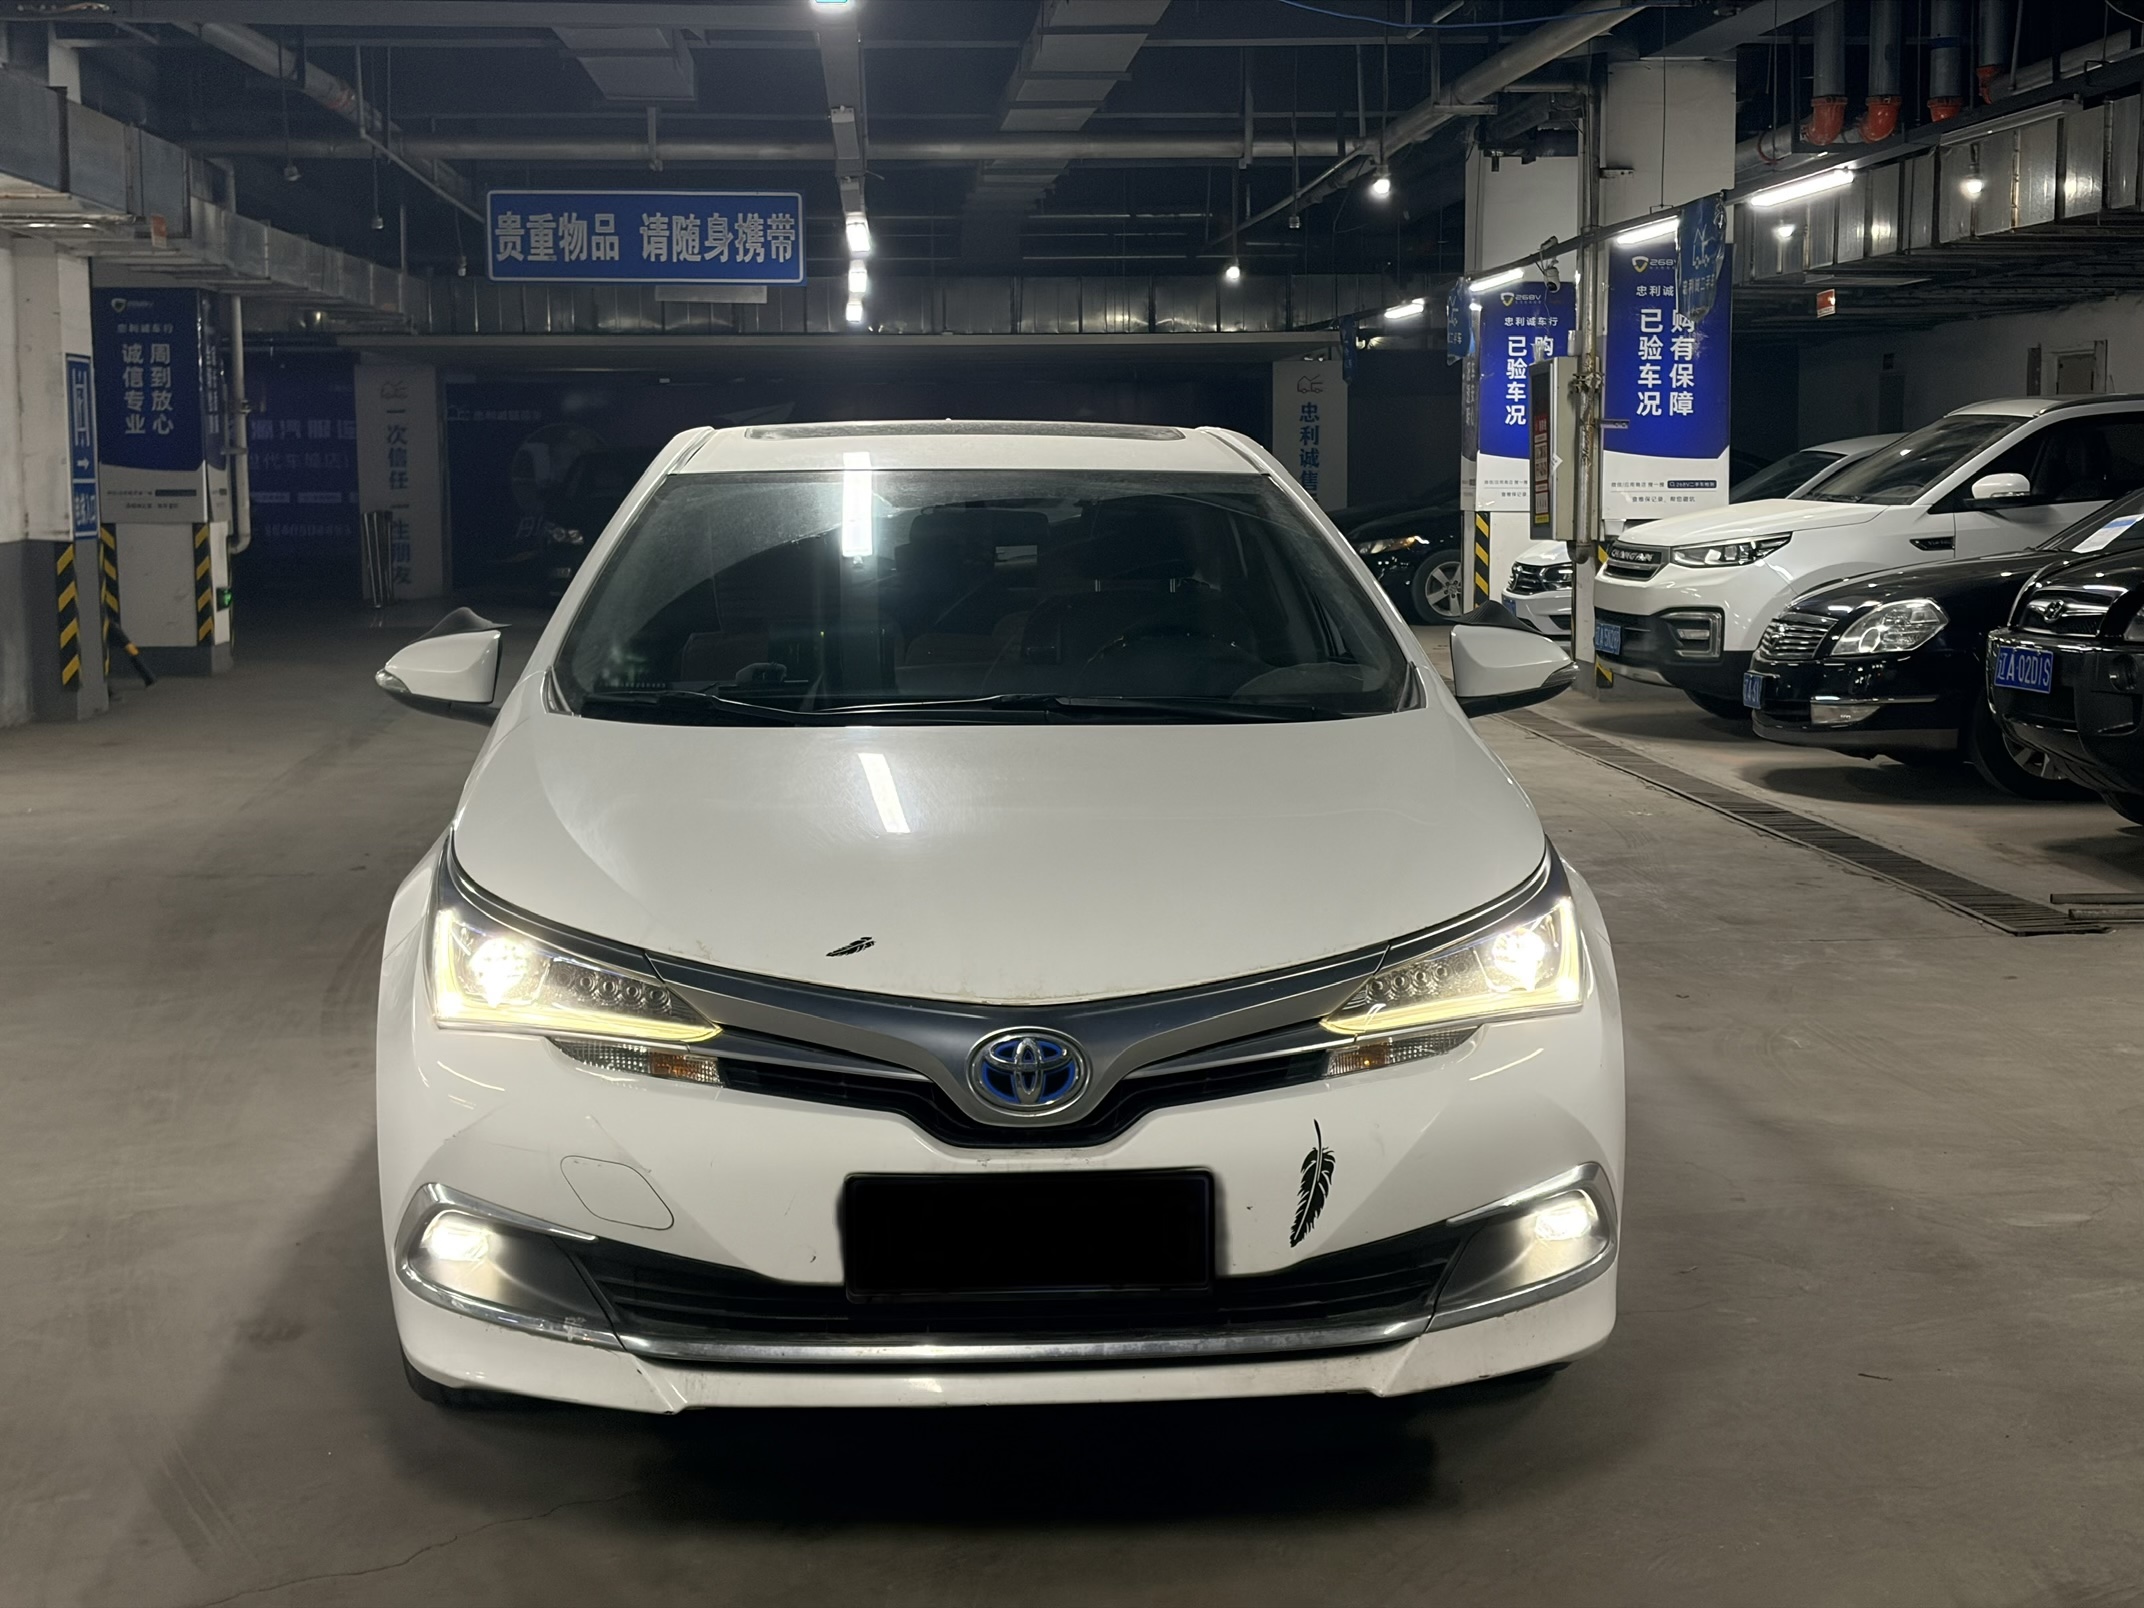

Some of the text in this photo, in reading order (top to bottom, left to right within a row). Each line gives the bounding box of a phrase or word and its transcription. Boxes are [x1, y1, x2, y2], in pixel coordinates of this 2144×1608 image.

[494, 210, 796, 263] 贵重物品 请随身携带
[1649, 258, 1676, 266] 268
[1504, 316, 1559, 327] 忠利诚车行
[1636, 308, 1663, 416] 已验车况
[1669, 310, 1696, 416] 购有保障
[121, 343, 146, 434] 诚信专业
[150, 343, 174, 435] 周到放心
[1505, 336, 1528, 426] 已验车况
[1299, 402, 1320, 501] 忠利诚售
